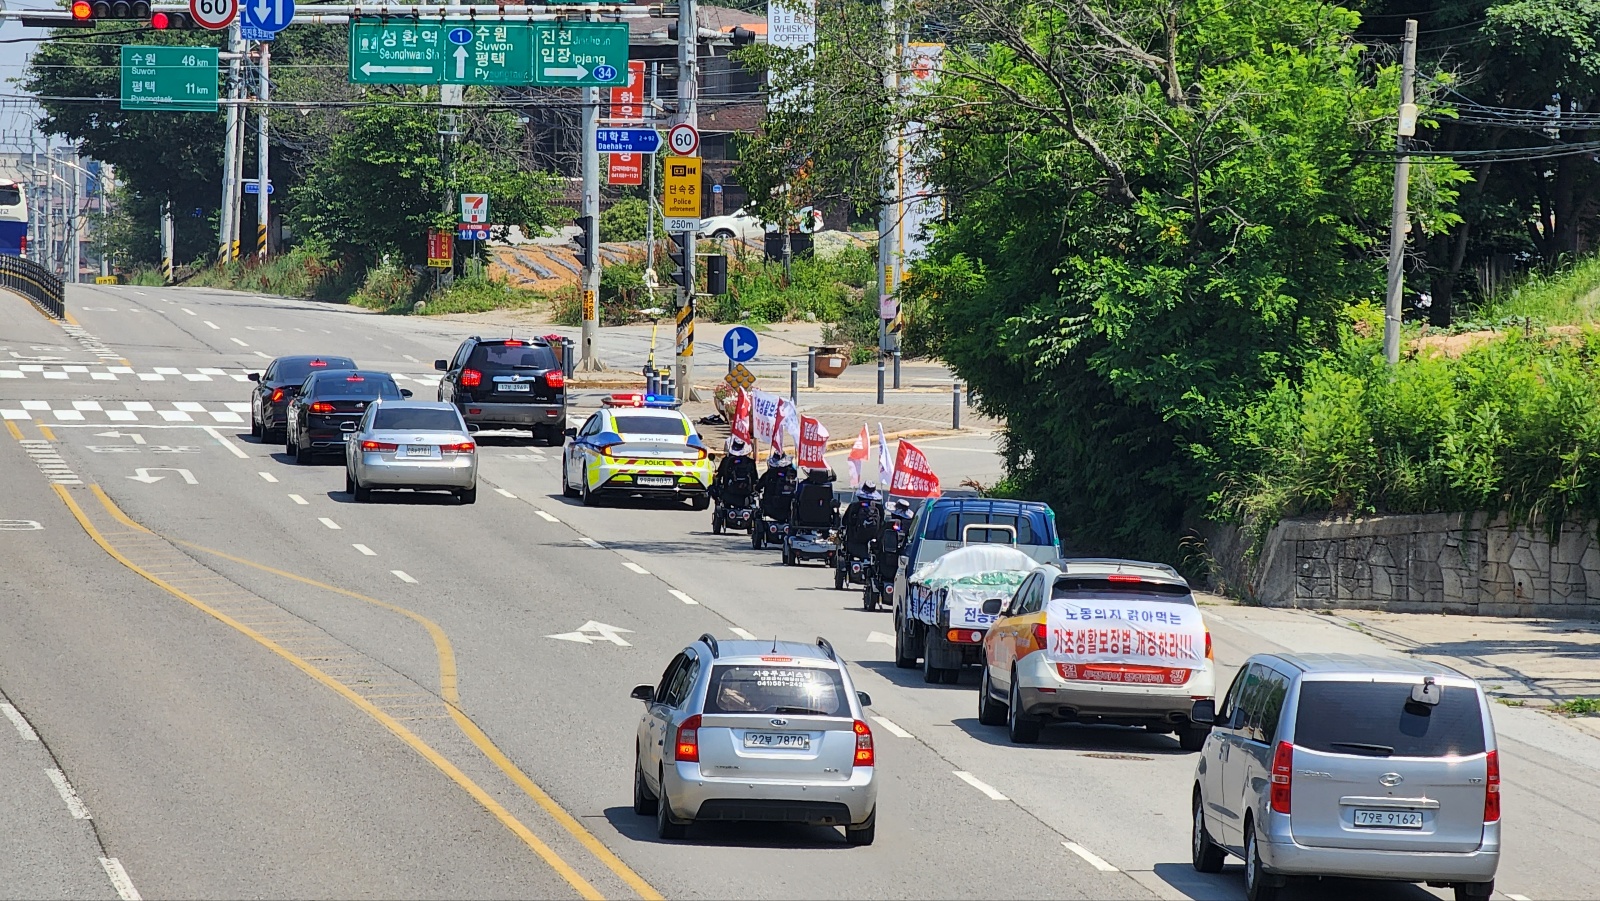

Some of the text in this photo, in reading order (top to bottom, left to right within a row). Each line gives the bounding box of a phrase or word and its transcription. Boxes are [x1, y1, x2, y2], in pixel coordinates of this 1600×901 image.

[200, 0, 227, 15] 60
[381, 29, 438, 47] 성환역
[457, 31, 463, 42] 1
[475, 26, 507, 42] 수원
[541, 29, 572, 45] 진천
[773, 34, 809, 42] COFFEE
[475, 41, 513, 51] Suwon
[131, 53, 156, 65] 수원
[475, 52, 505, 67] 평택
[541, 48, 571, 63] 입장
[572, 53, 606, 65] Ipjang
[131, 67, 156, 75] Suwon
[598, 68, 611, 78] 34
[132, 81, 156, 93] 평택
[598, 131, 630, 143] 대학로
[675, 133, 692, 146] 60
[669, 184, 696, 195] 단속중
[671, 220, 694, 229] 250m
[1053, 628, 1131, 655] 기초생활보장법
[751, 734, 804, 746] 22부 7870
[1360, 812, 1416, 825] 79로 9162
